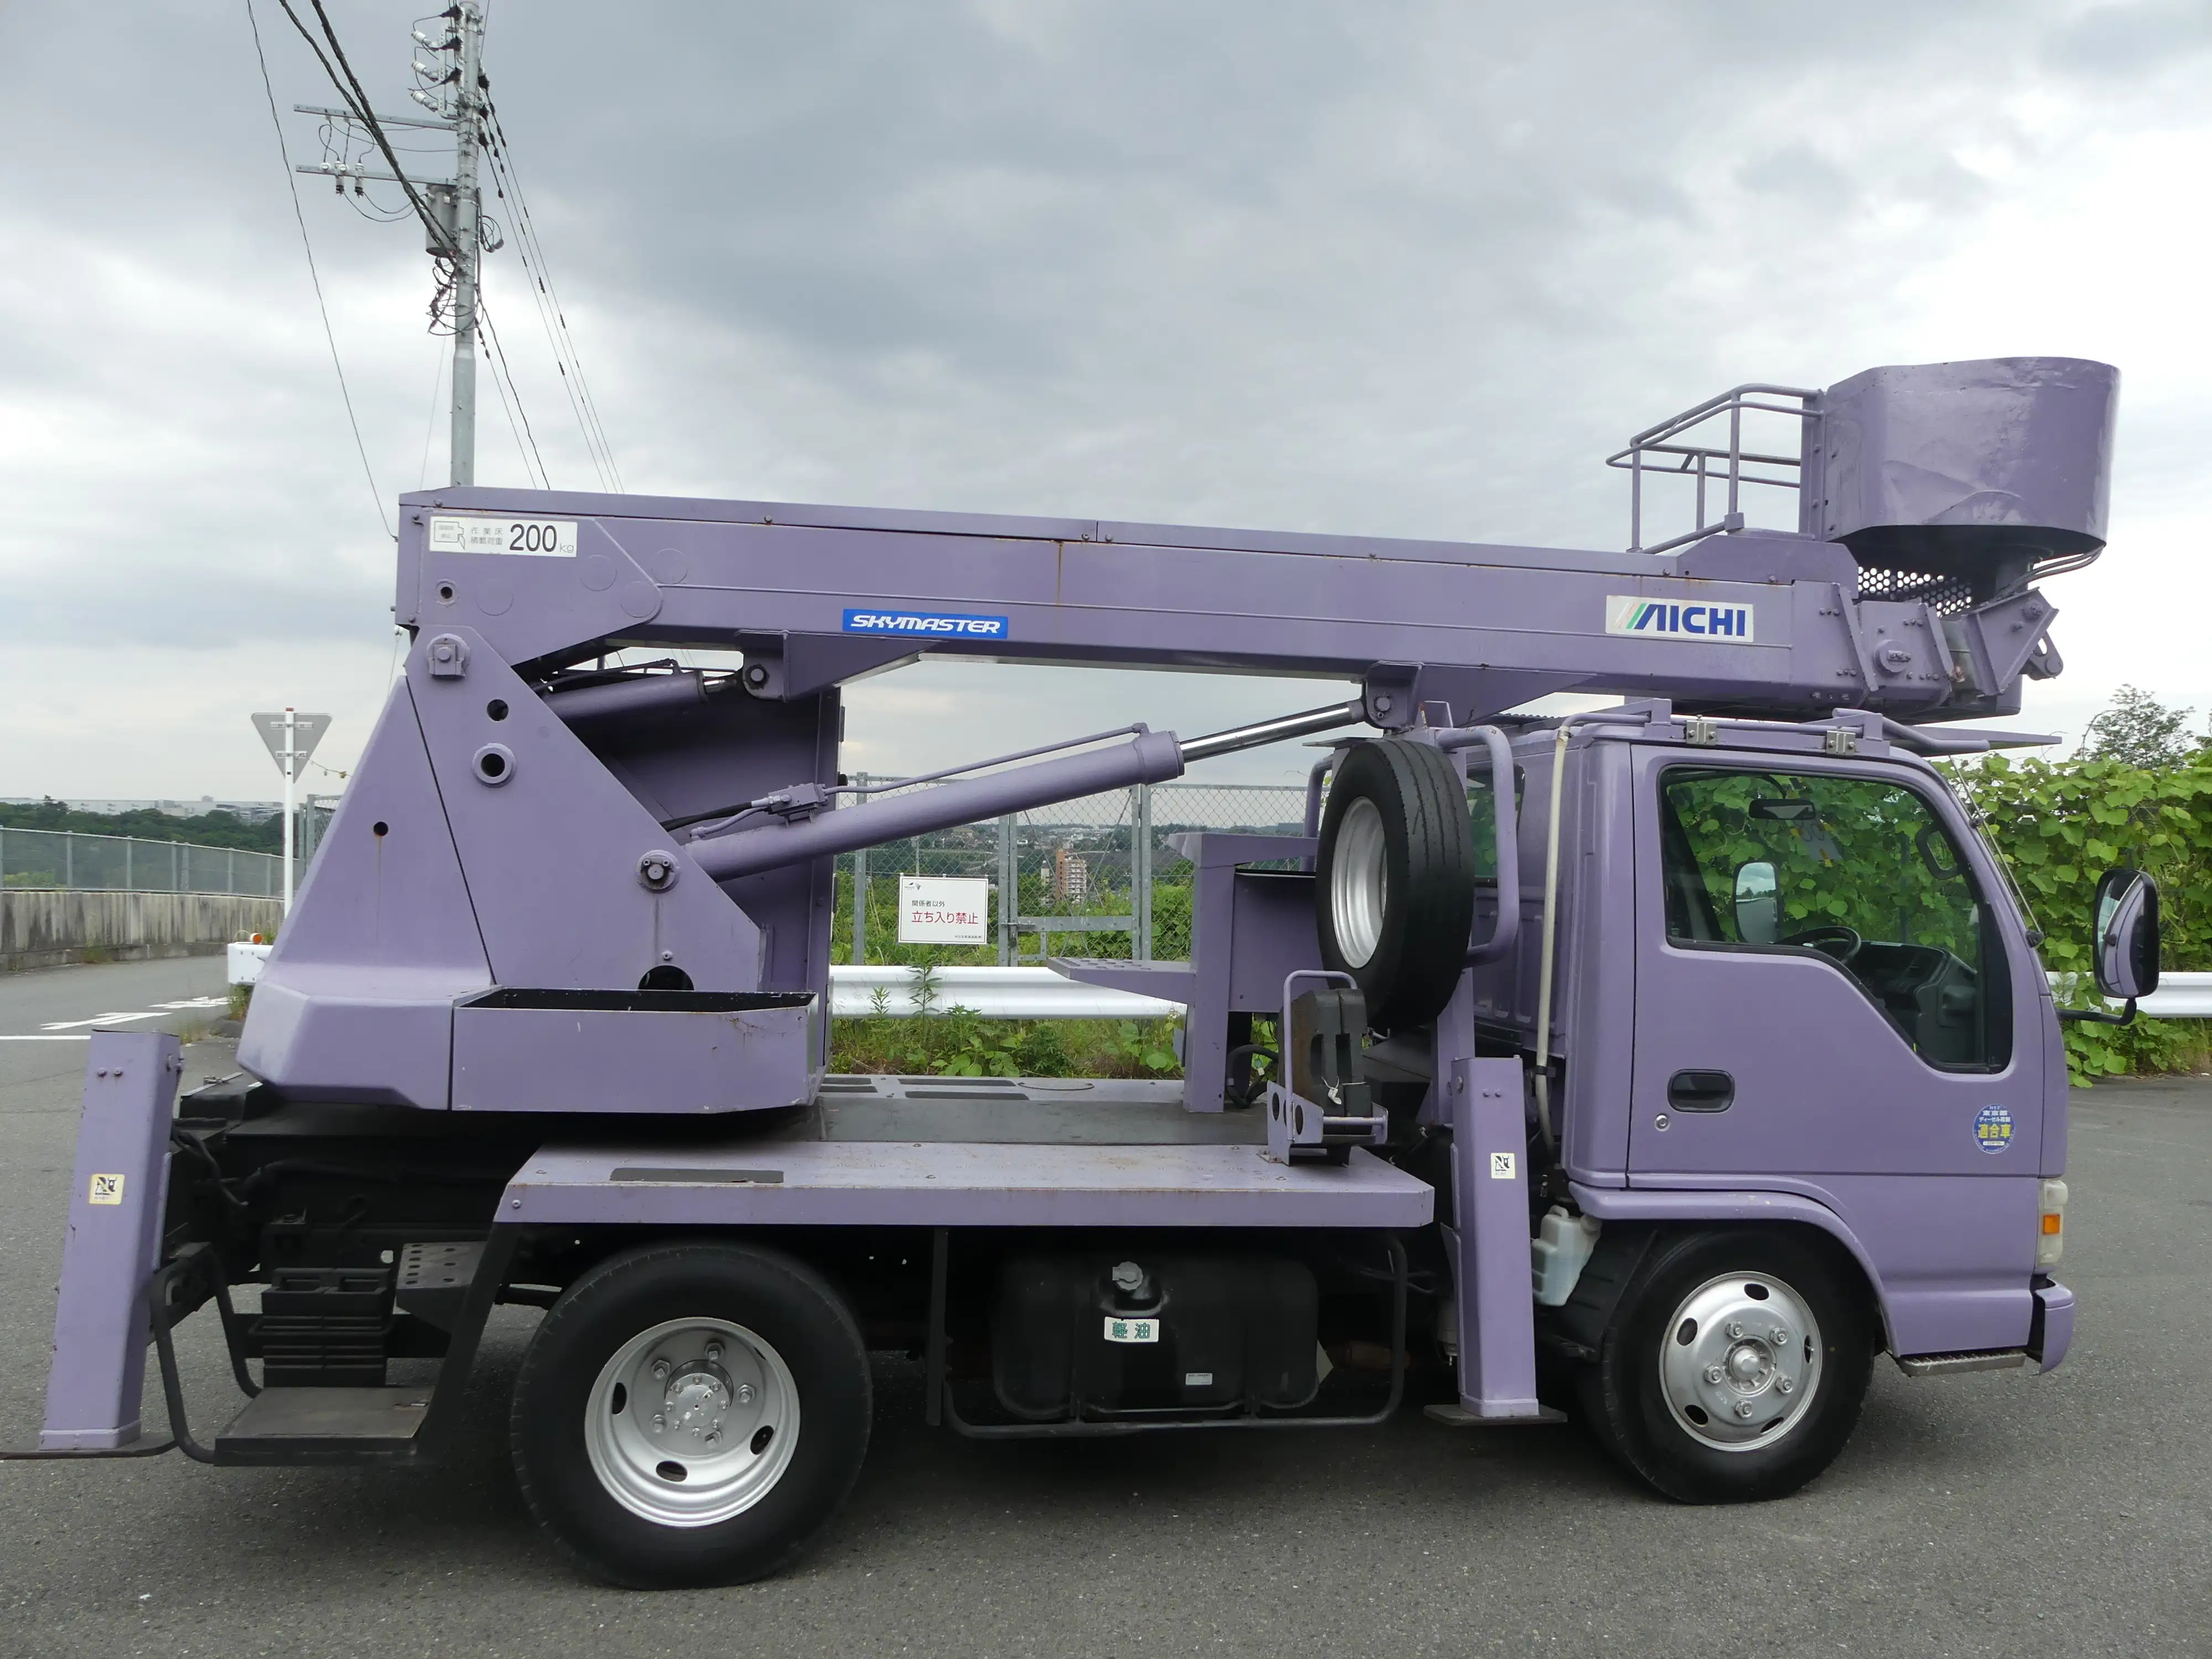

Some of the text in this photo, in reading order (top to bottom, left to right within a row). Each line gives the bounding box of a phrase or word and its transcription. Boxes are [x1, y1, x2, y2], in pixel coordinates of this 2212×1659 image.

[509, 523, 575, 554] 200 kg
[851, 614, 1001, 634] SKYMASTER
[1634, 603, 1746, 637] AICHI
[911, 910, 978, 924] 立ち入り禁止
[1978, 1123, 2011, 1139] 適合車
[1112, 1321, 1151, 1339] 軽油
